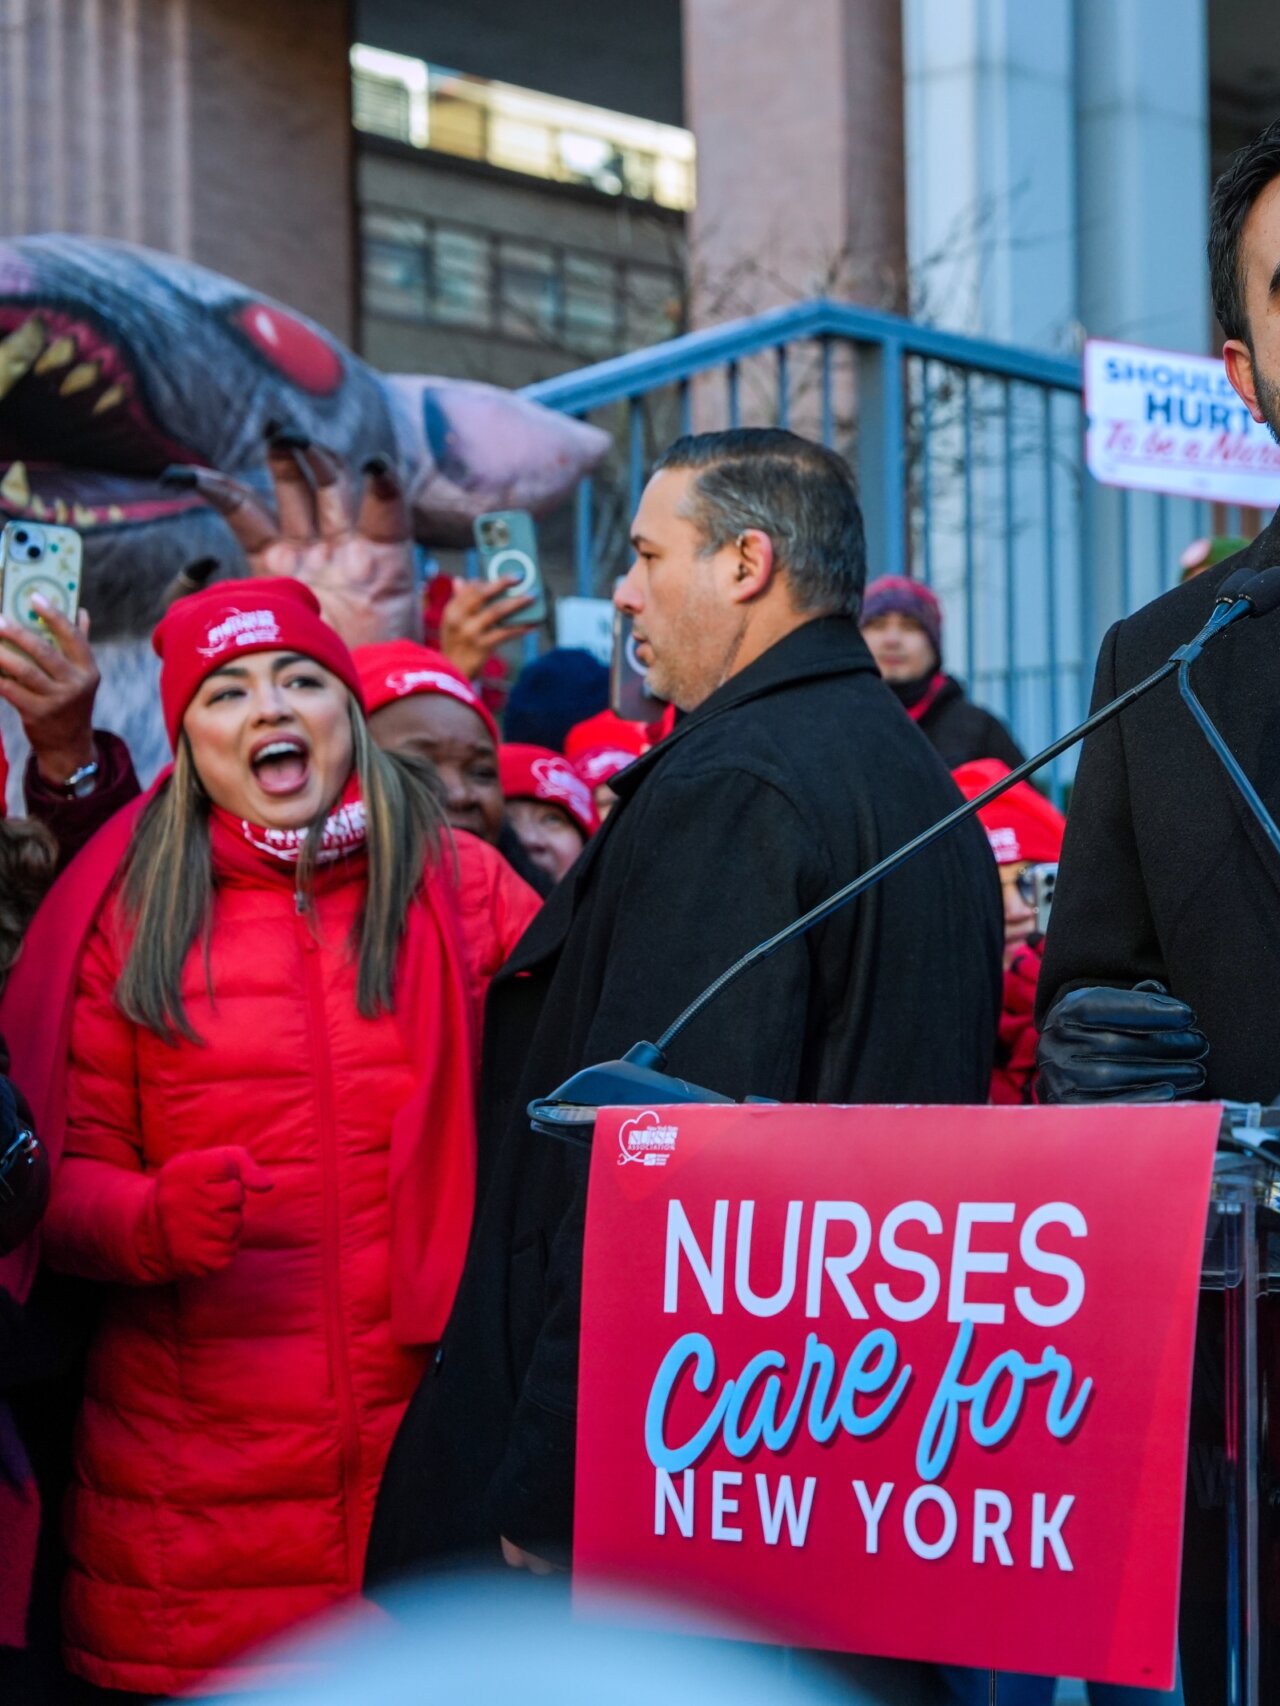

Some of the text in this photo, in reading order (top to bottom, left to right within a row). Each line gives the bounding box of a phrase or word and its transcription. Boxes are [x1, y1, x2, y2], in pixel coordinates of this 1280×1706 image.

[1147, 394, 1253, 434] HURT
[629, 1130, 678, 1145] NURSES
[663, 1199, 1088, 1327] NURSES
[645, 1319, 1093, 1481] Care for
[653, 1467, 1076, 1572] NEW YORK
